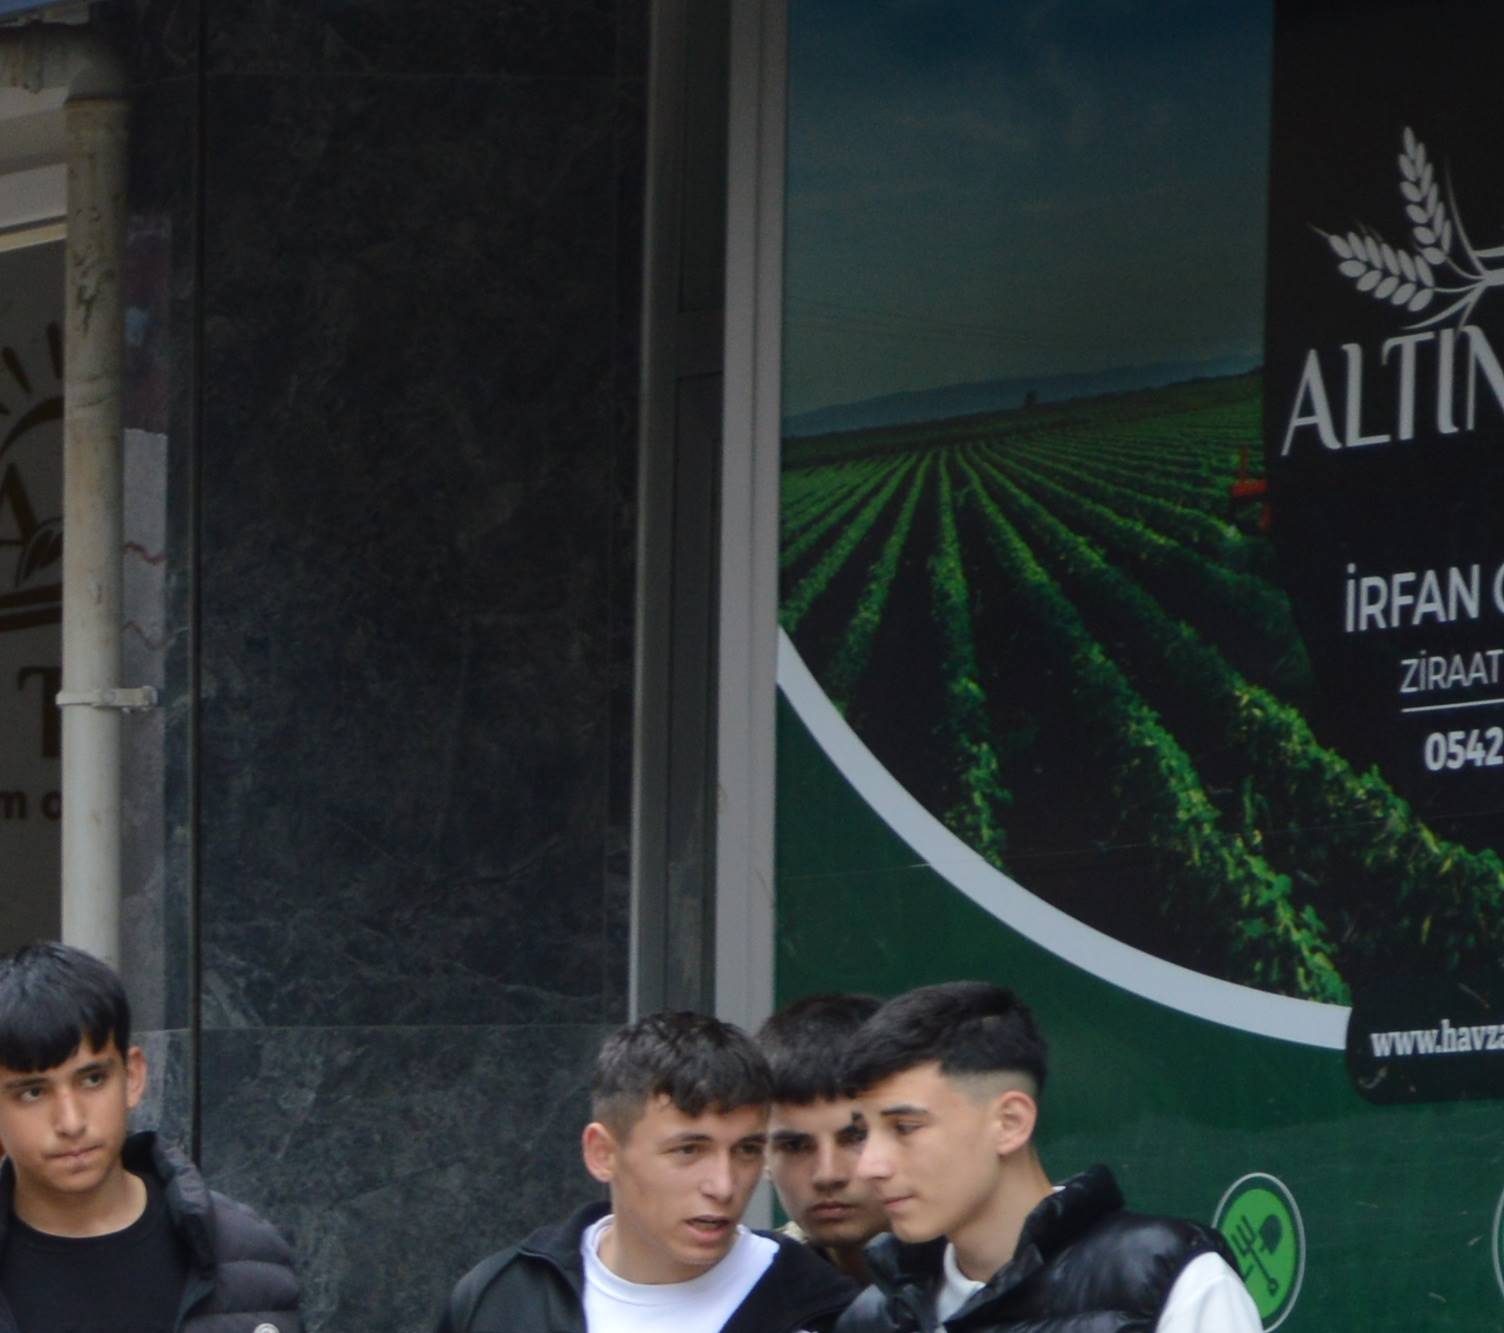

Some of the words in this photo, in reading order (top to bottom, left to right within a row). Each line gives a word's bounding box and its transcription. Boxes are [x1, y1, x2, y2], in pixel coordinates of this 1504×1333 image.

[1345, 563, 1480, 633] İRFAN
[1400, 650, 1504, 693] ZİRAAT
[1425, 726, 1504, 771] 0542
